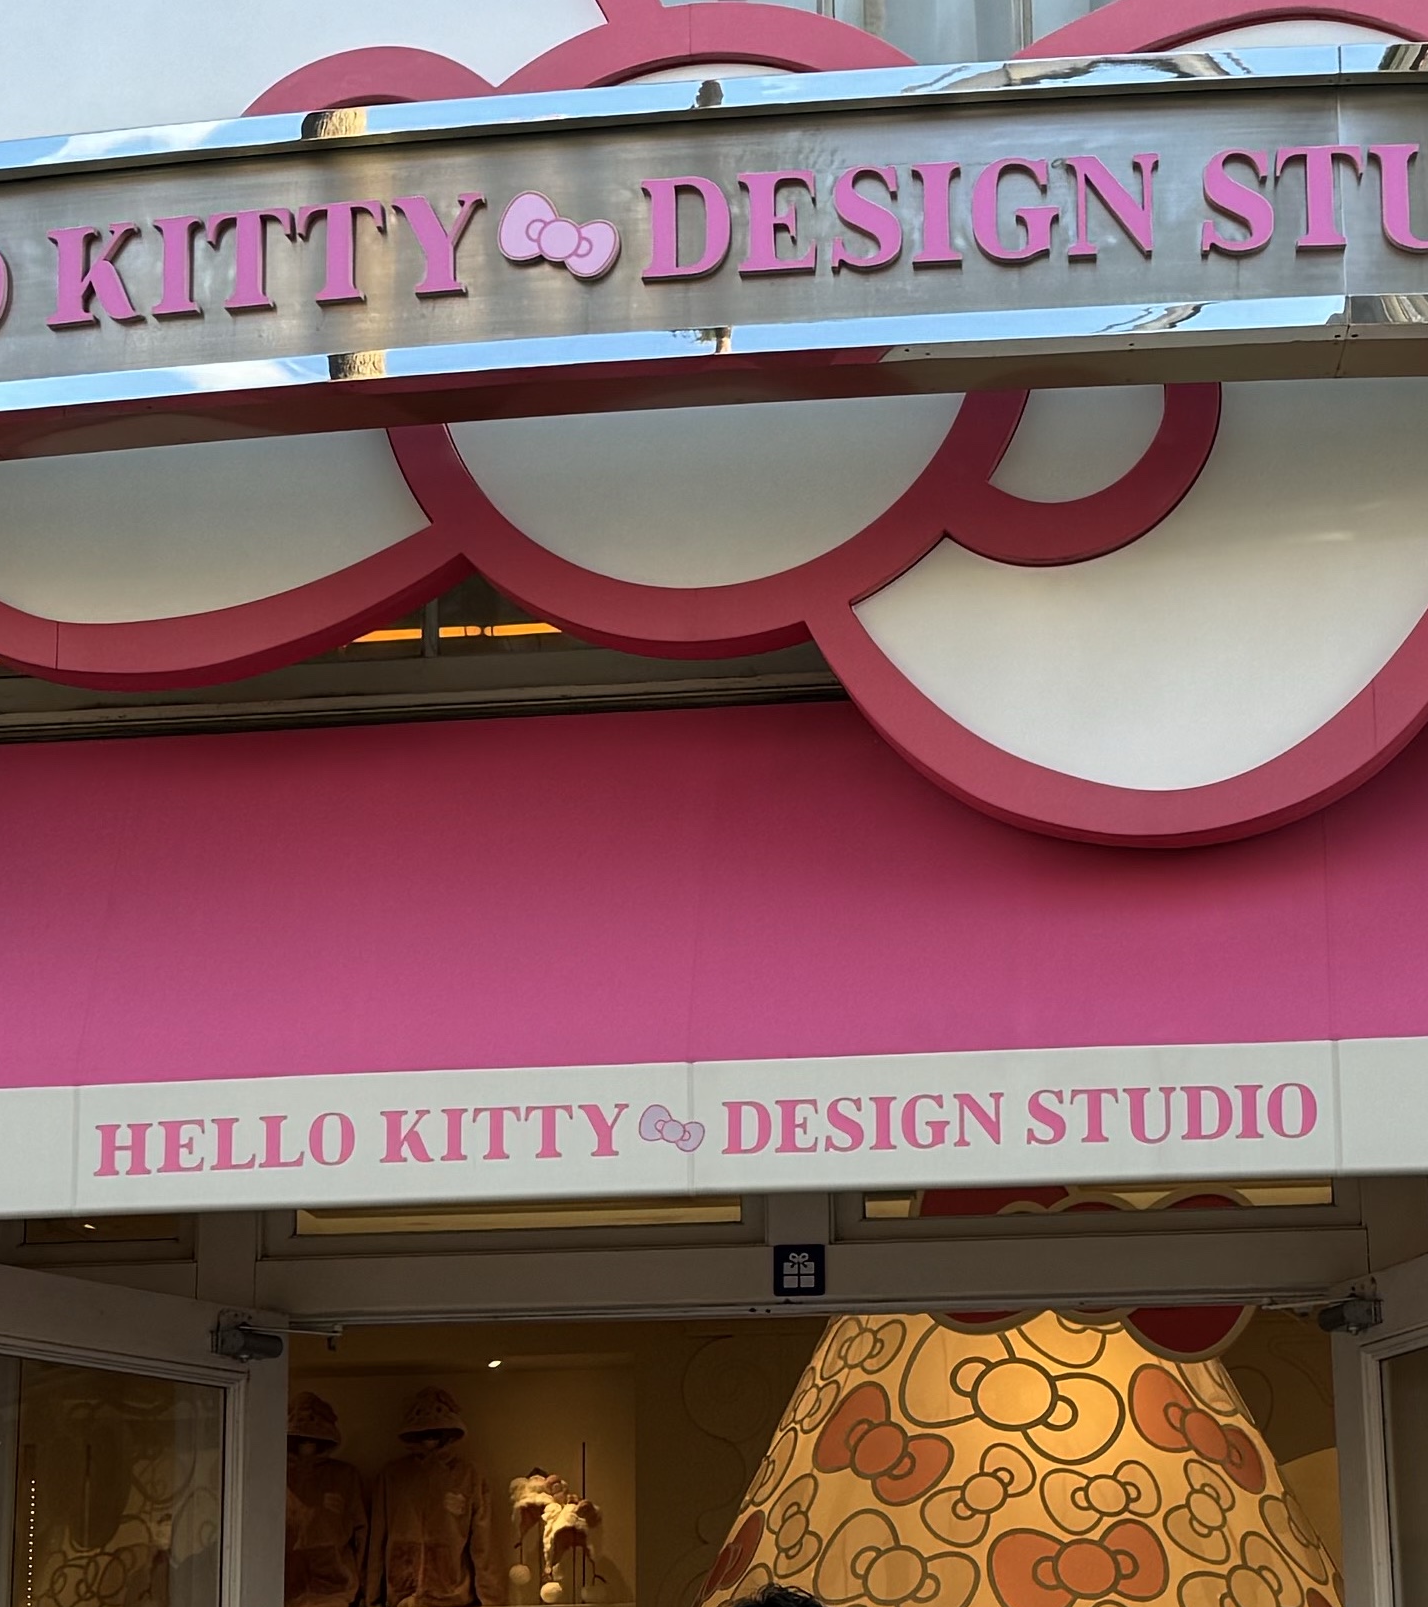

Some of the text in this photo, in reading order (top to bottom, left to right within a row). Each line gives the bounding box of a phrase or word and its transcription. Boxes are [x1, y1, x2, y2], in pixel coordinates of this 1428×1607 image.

[45, 190, 486, 328] KITTY
[640, 150, 1160, 281] DESIGN
[94, 1083, 1319, 1178] HELLO KITTY DESIGN STUDIO
